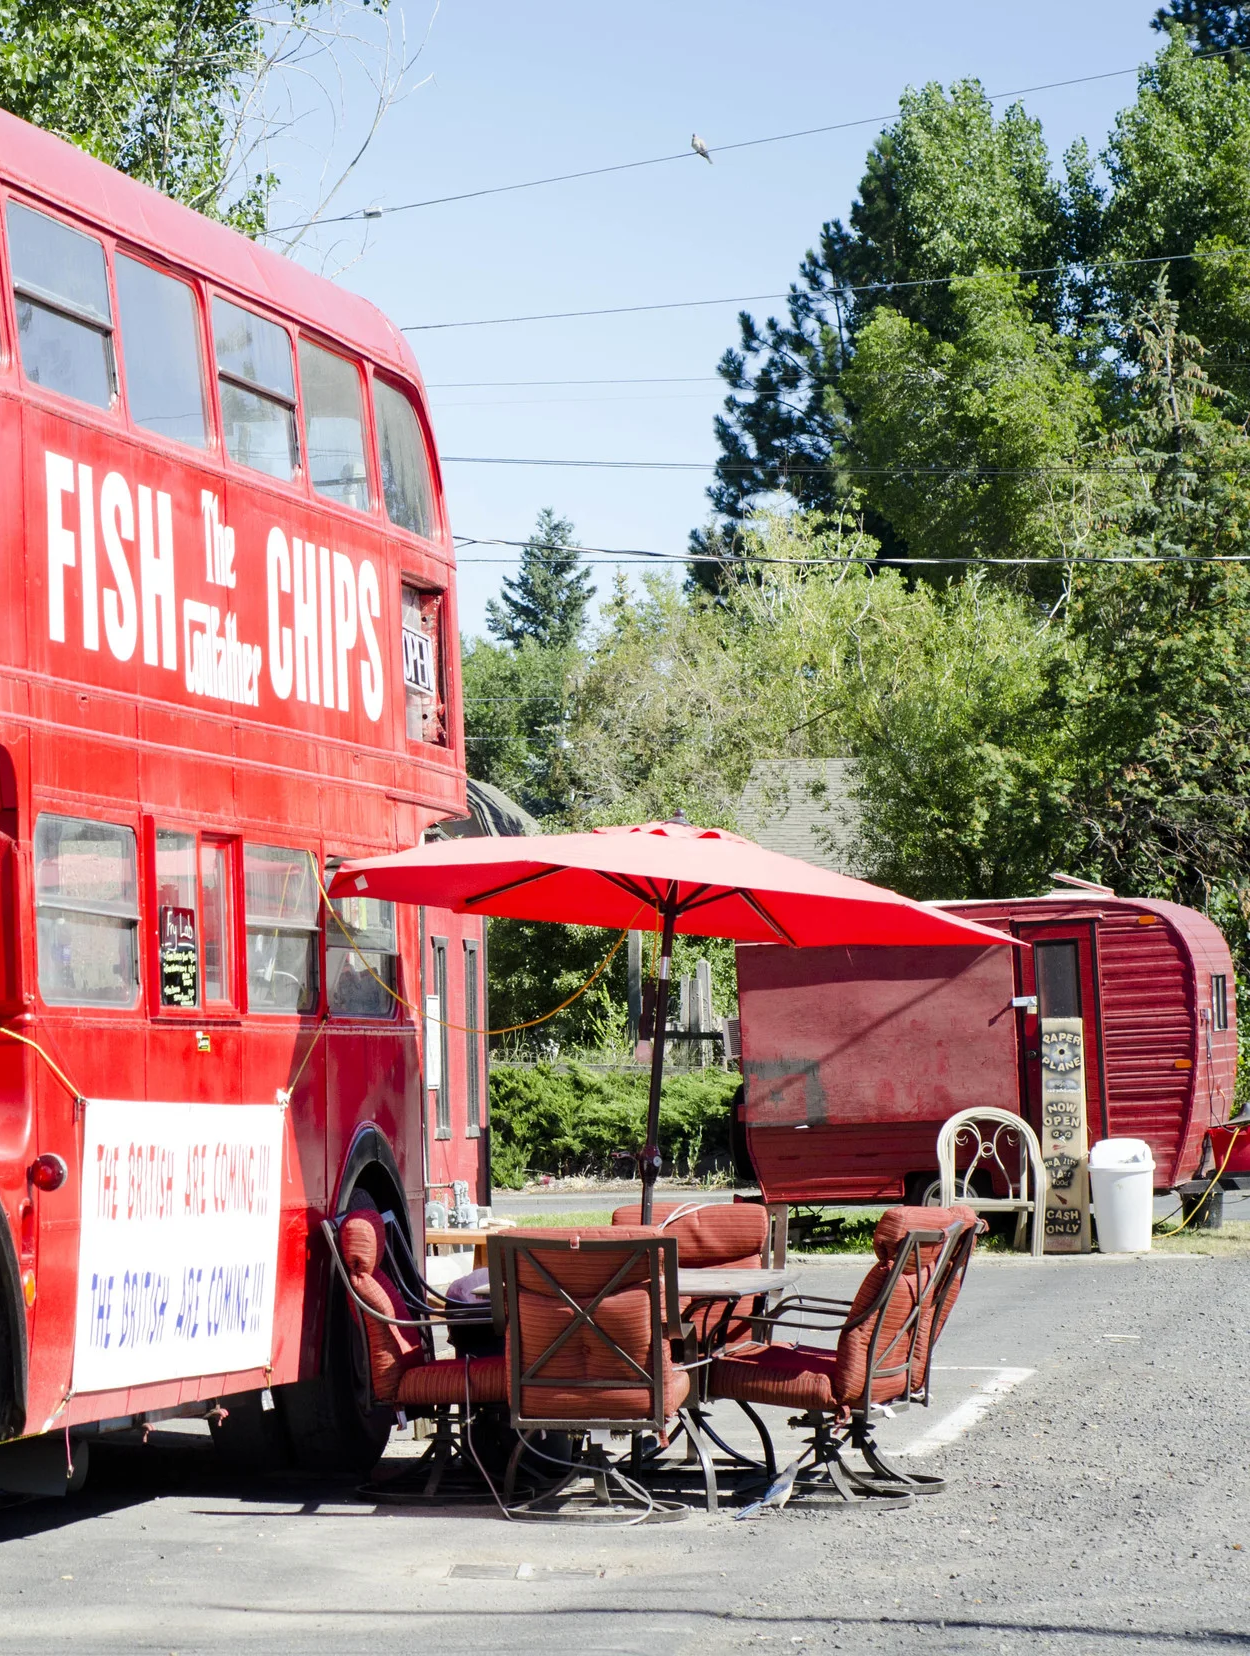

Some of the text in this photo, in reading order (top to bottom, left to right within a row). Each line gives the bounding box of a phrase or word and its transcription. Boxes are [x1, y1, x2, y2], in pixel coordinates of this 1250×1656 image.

[44, 450, 178, 672] FISH
[201, 488, 236, 589] The
[266, 525, 385, 722] CHIPS
[183, 598, 262, 708] Codfather
[403, 630, 432, 688] OPEN
[1042, 1032, 1081, 1046] PAPER
[1042, 1056, 1081, 1072] PLANE
[1043, 1116, 1081, 1128] OPEN
[1047, 1102, 1077, 1114] NOW
[97, 1143, 119, 1221] THE
[127, 1141, 175, 1222] BRITISH
[184, 1143, 207, 1217] ARE
[1045, 1223, 1079, 1234] ONLY
[1046, 1209, 1079, 1220] CASH
[90, 1272, 114, 1350] THE
[118, 1269, 170, 1349] BRITISH
[174, 1265, 202, 1341] ARE
